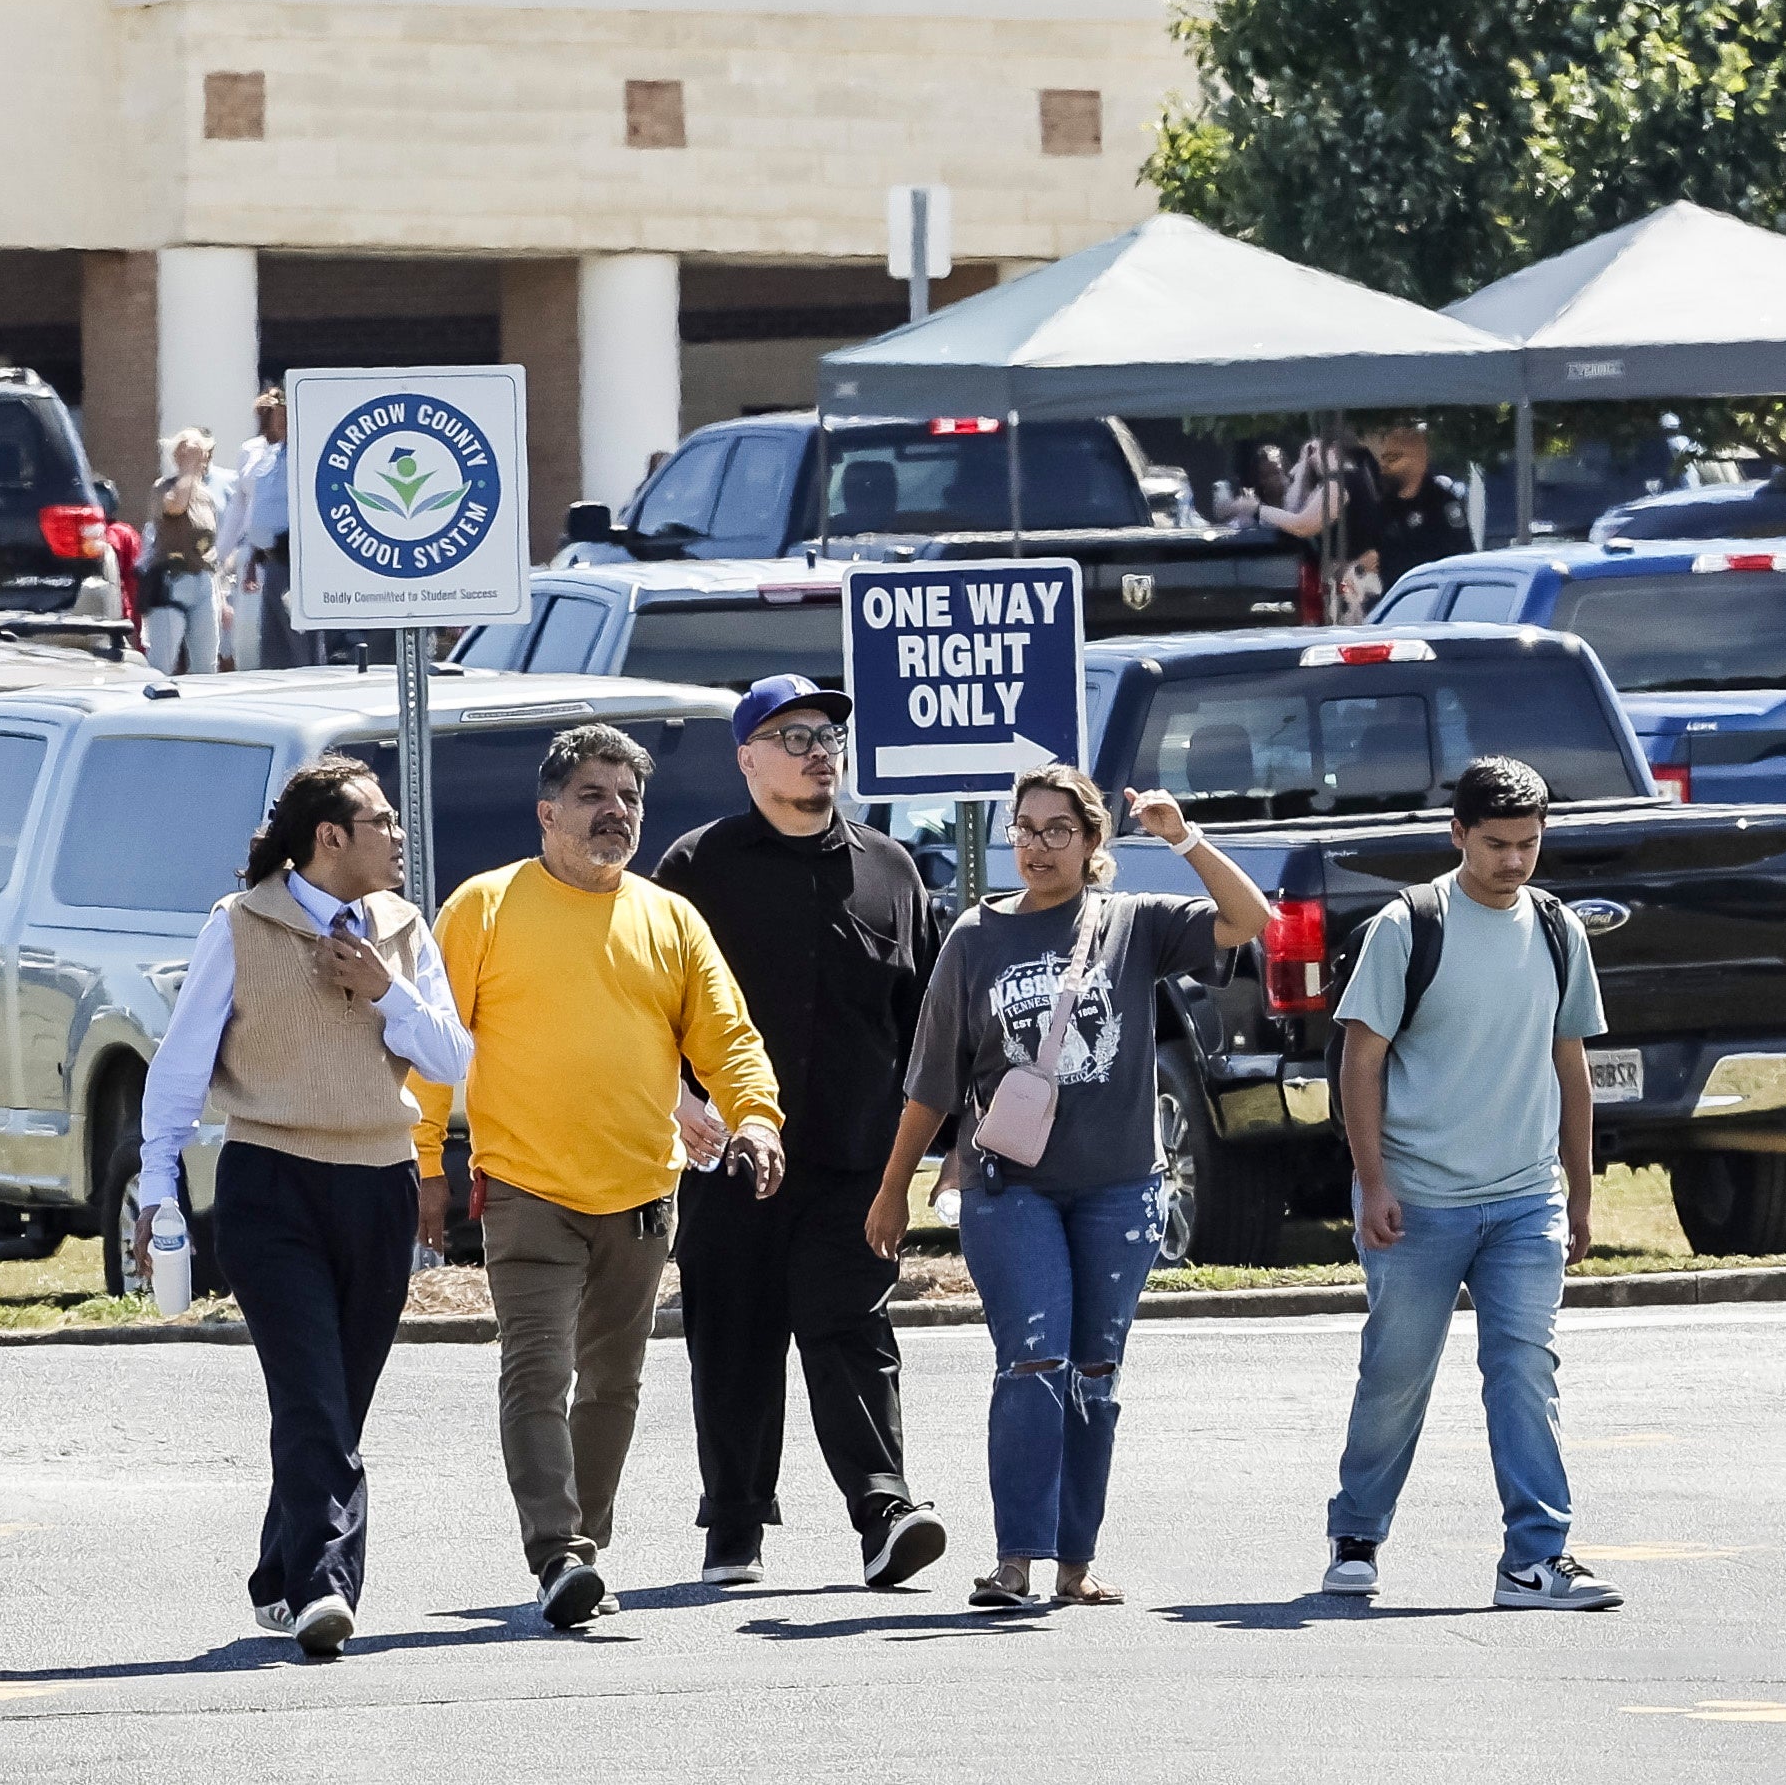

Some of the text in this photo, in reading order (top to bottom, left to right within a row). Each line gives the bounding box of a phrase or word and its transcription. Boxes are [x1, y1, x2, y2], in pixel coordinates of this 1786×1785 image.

[328, 402, 488, 471] BARROW COUNTY
[330, 501, 489, 569] SCHOOL SYSTEM
[322, 588, 498, 605] Boldly Committed to Student Success
[862, 581, 1064, 630] ONE WAY
[897, 631, 1031, 678] RIGHT
[907, 681, 1025, 729] ONLY
[1012, 1017, 1033, 1030] EST
